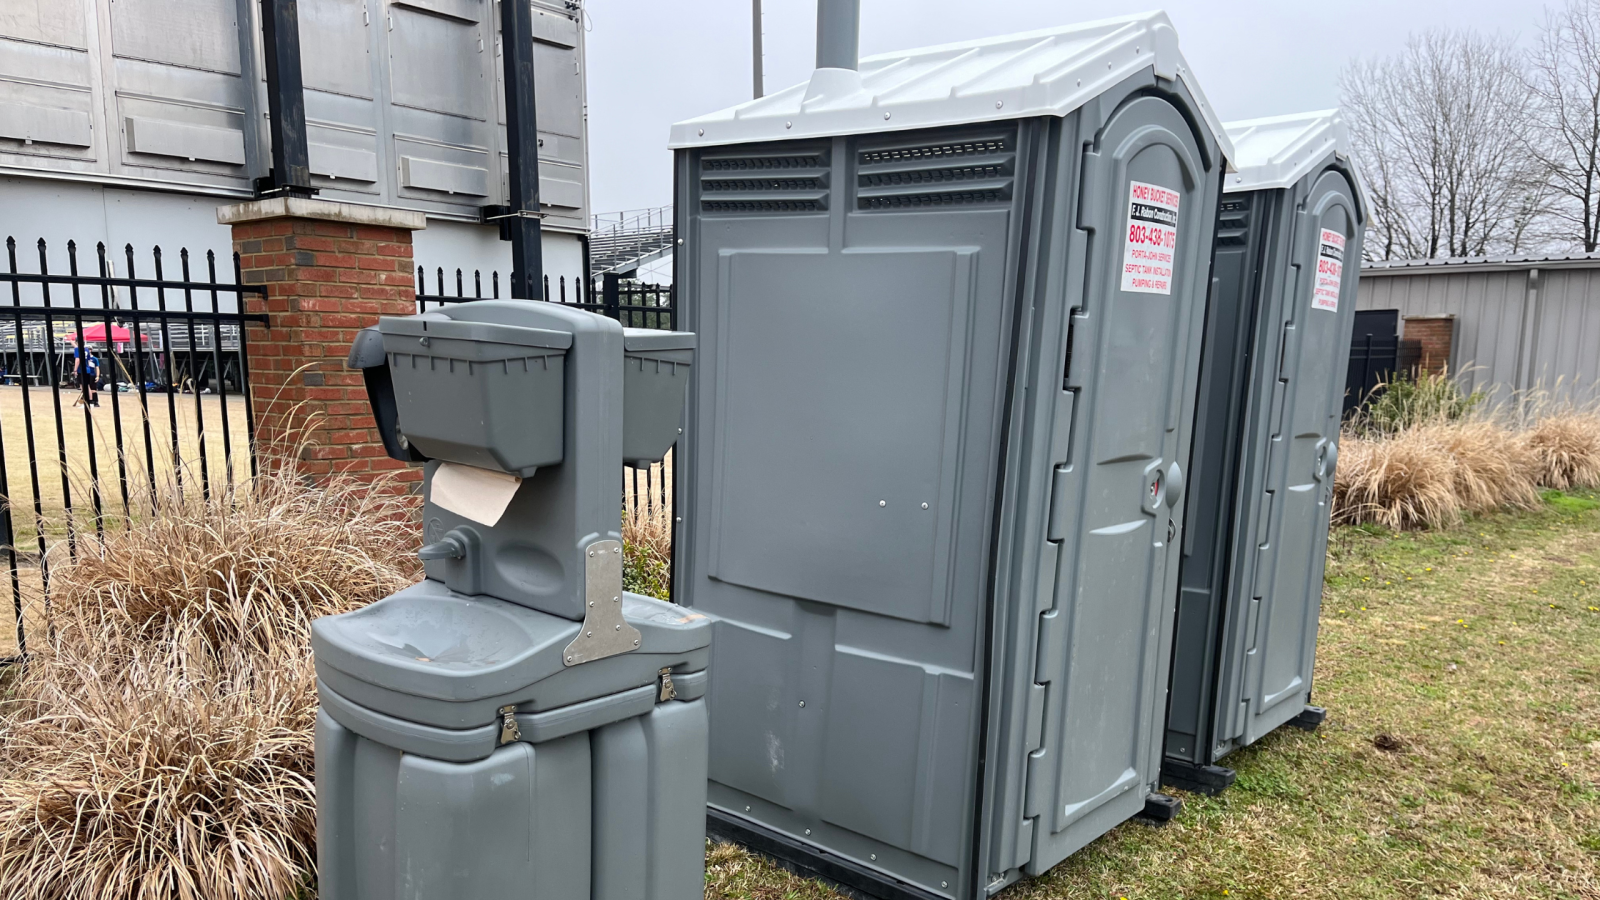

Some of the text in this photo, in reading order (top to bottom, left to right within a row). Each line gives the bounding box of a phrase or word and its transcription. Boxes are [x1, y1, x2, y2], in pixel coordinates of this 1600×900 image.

[1133, 185, 1150, 200] HONEY
[1150, 188, 1166, 204] BUCKET
[1129, 225, 1175, 249] 803-438-1075
[1125, 263, 1142, 274] SEPTIC
[1142, 264, 1153, 275] TANK
[1132, 278, 1152, 289] PUMPING
